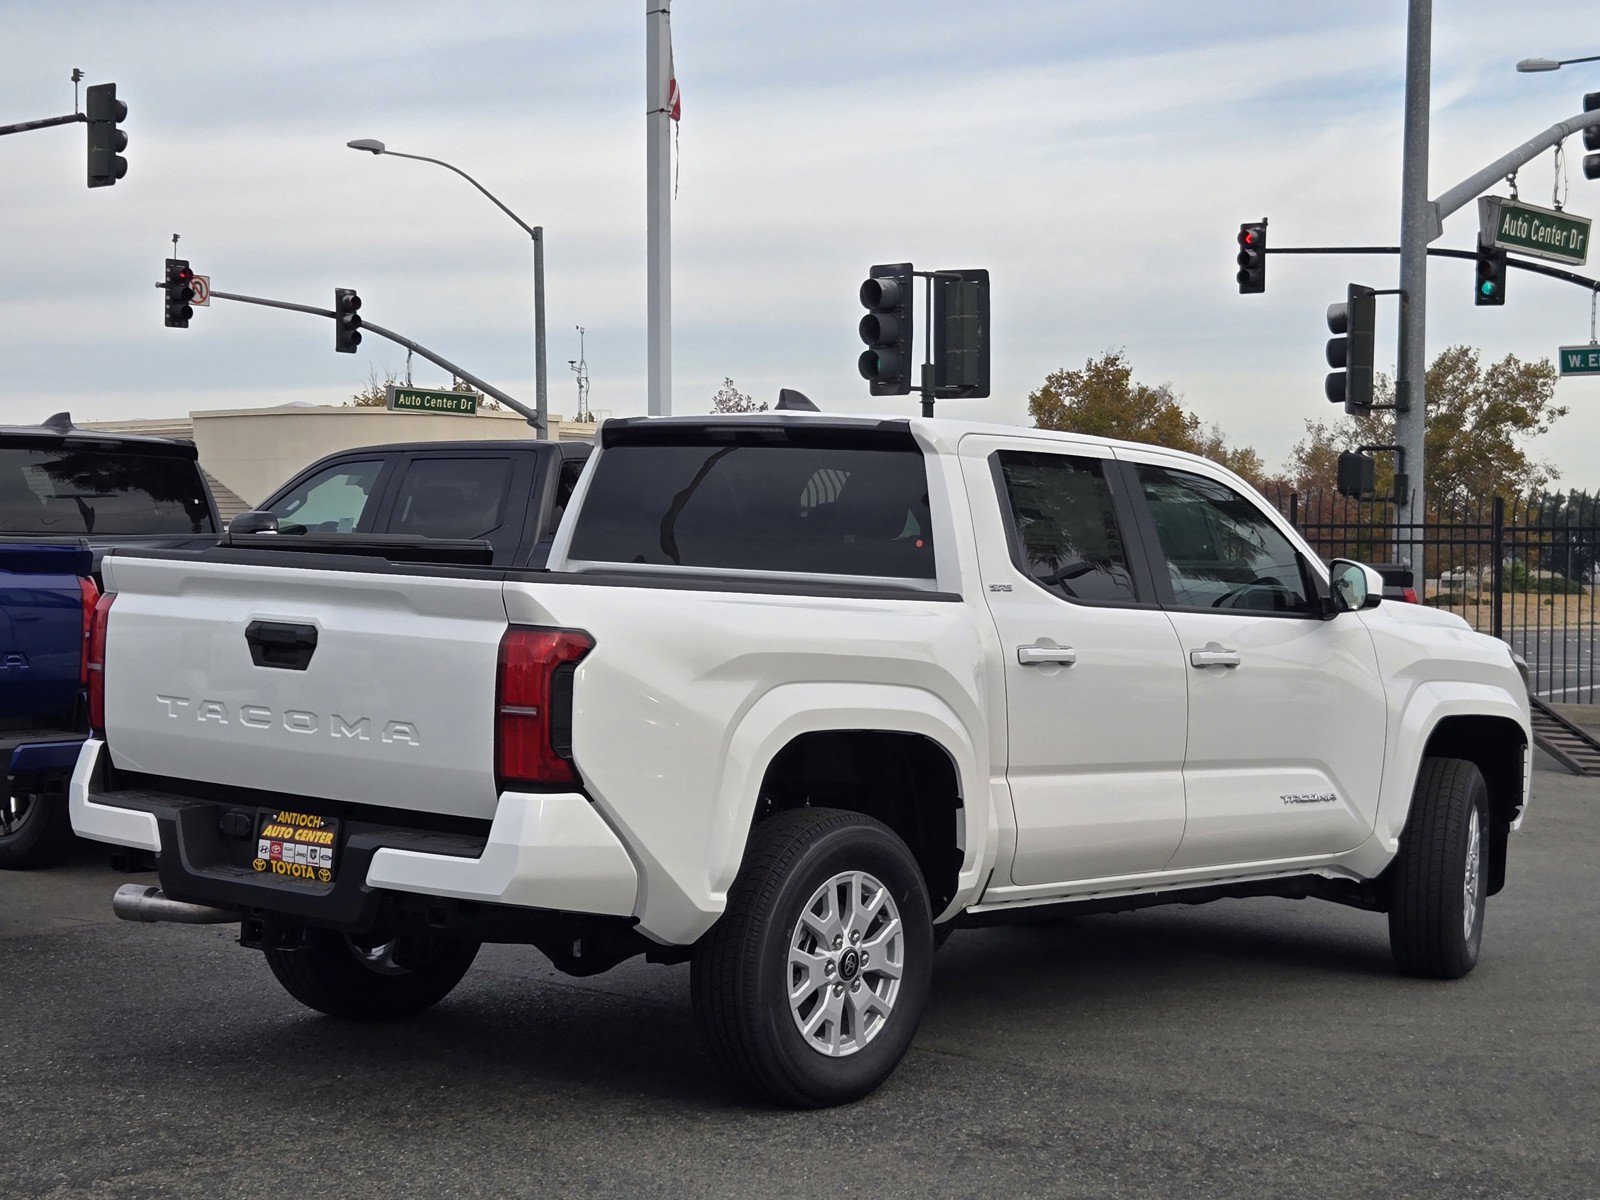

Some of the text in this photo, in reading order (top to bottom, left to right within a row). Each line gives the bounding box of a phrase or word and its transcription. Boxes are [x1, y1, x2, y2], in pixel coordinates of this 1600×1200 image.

[1502, 213, 1584, 250] Auto Center Dr
[1568, 354, 1585, 368] W.
[398, 393, 473, 410] Auto Center Dr
[156, 694, 420, 746] TACOMA
[277, 811, 321, 828] ANTIOCH
[262, 825, 334, 844] AUTO CENTER
[271, 860, 315, 879] TOYOTA
